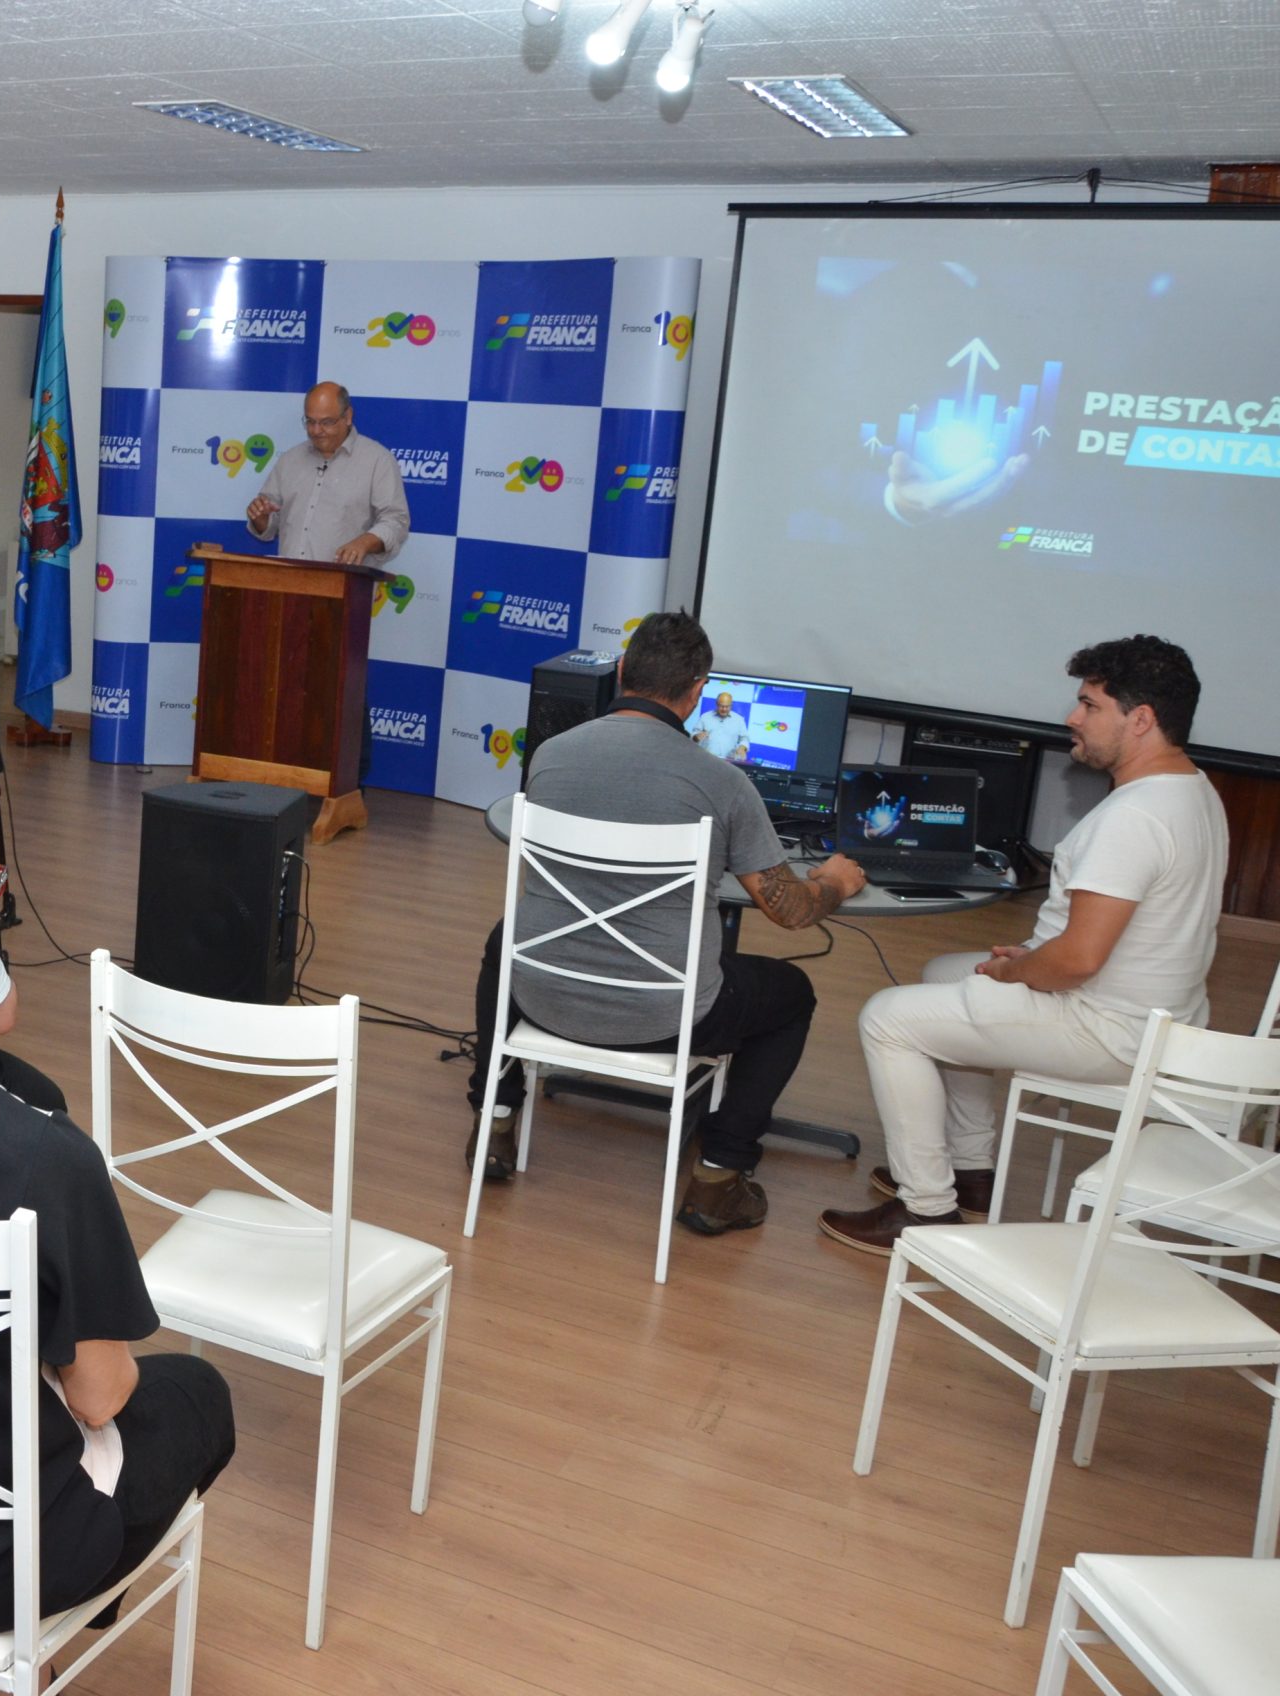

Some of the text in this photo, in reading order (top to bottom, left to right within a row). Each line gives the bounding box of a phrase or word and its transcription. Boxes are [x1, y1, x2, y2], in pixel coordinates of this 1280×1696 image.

[531, 314, 599, 326] PREFEITURA
[221, 319, 306, 339] FRANCA
[333, 325, 366, 335] Franca
[621, 323, 652, 333] Franca
[525, 325, 597, 346] FRANCA
[1077, 429, 1280, 469] DE CONTA
[171, 433, 275, 479] Franca 199
[475, 468, 505, 478] Franca
[1029, 536, 1093, 553] FRANCA
[505, 594, 571, 614] PREFEITURA
[499, 605, 569, 633] FRANCA
[592, 623, 621, 635] Franca
[160, 700, 191, 710] Franca
[452, 728, 479, 741] Franca
[910, 804, 965, 814] PRESTAÇÃO
